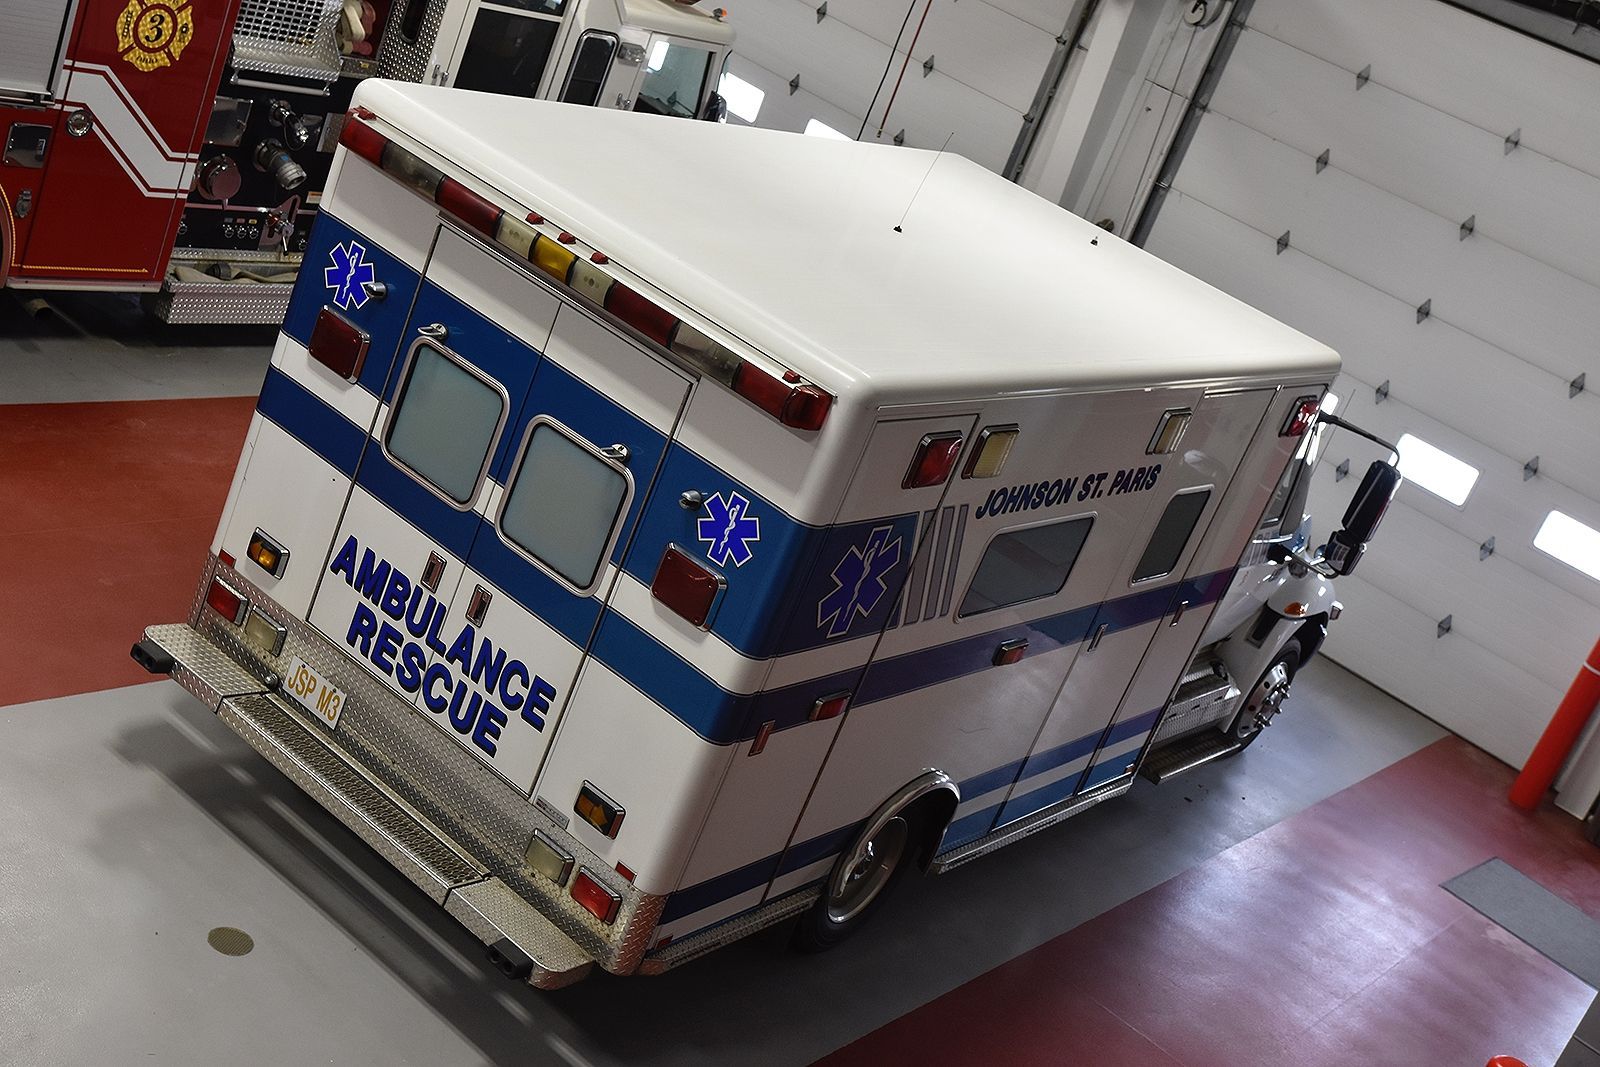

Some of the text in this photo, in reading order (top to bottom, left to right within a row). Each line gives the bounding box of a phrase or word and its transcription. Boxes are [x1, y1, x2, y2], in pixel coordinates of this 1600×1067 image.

[145, 13, 165, 43] 3
[975, 464, 1162, 519] JOHNSON ST. PARIS
[329, 534, 557, 733] AMBULANCE
[288, 665, 341, 721] JSP M3
[346, 600, 508, 759] RESCUE
